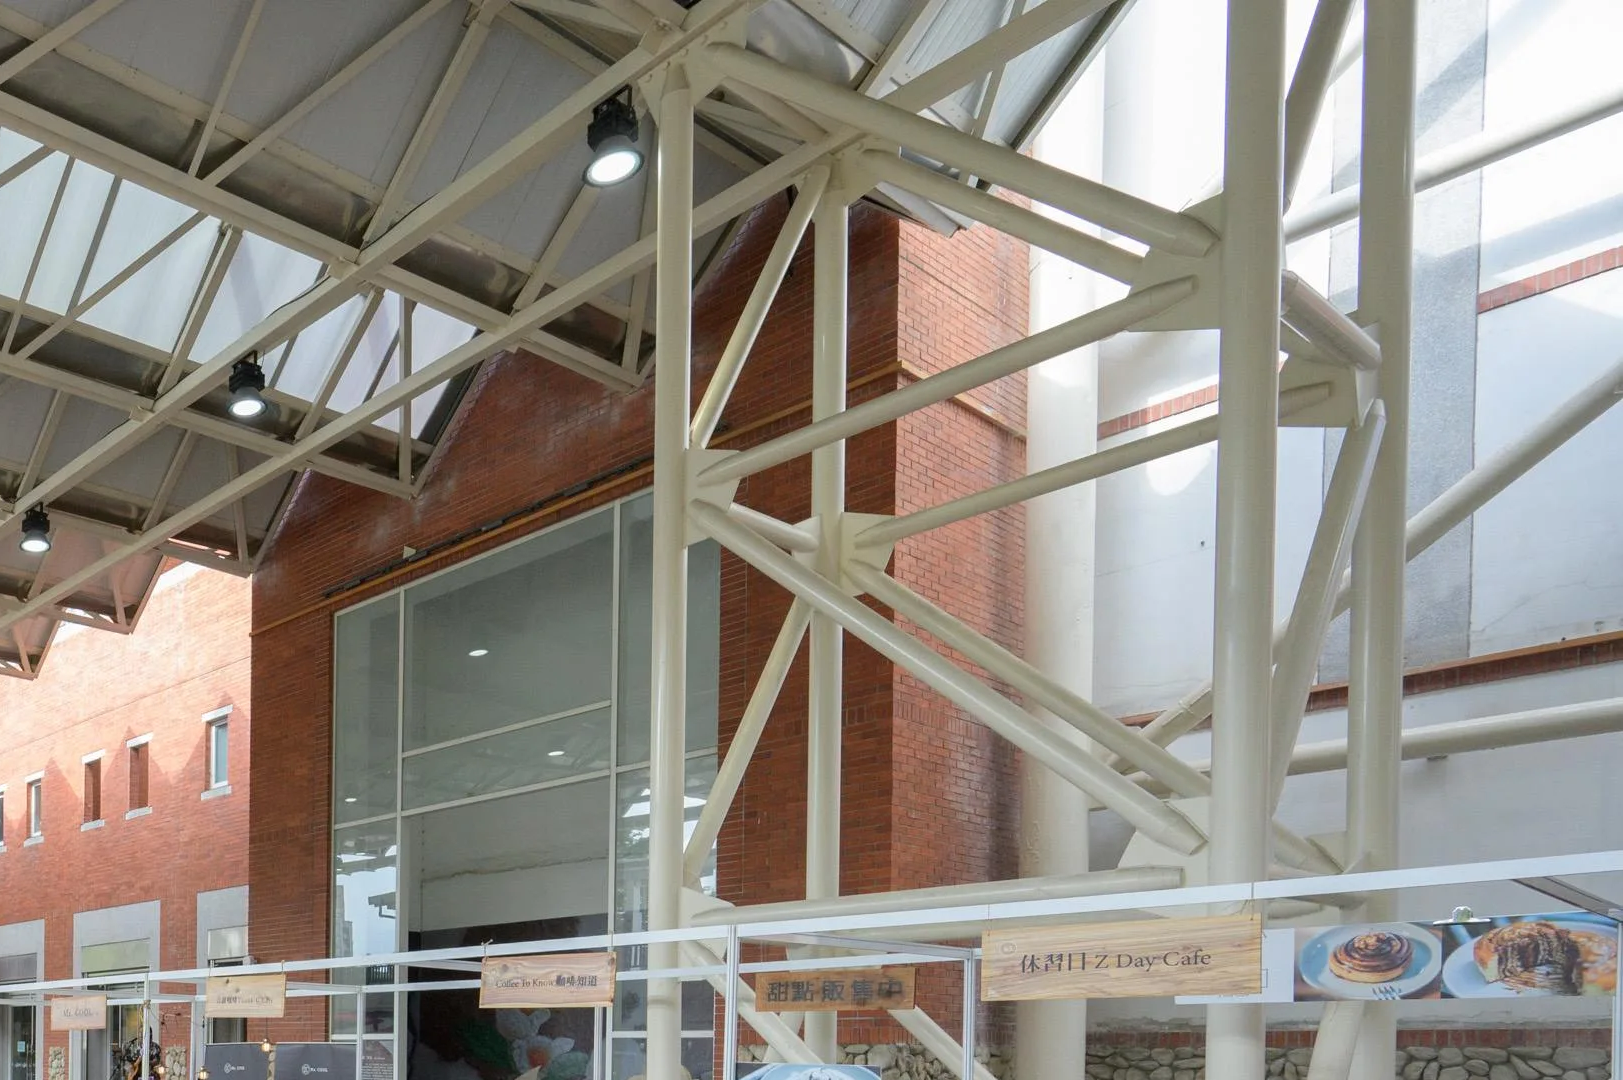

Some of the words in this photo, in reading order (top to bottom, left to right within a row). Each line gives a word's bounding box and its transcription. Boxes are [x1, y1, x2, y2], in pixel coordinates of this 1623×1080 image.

[1094, 954, 1110, 970] Z
[1116, 953, 1157, 972] Day
[1162, 948, 1212, 968] Cafe
[496, 978, 520, 989] Coffee
[522, 978, 531, 988] To
[532, 977, 555, 987] Know
[555, 974, 598, 987] 咖啡知道
